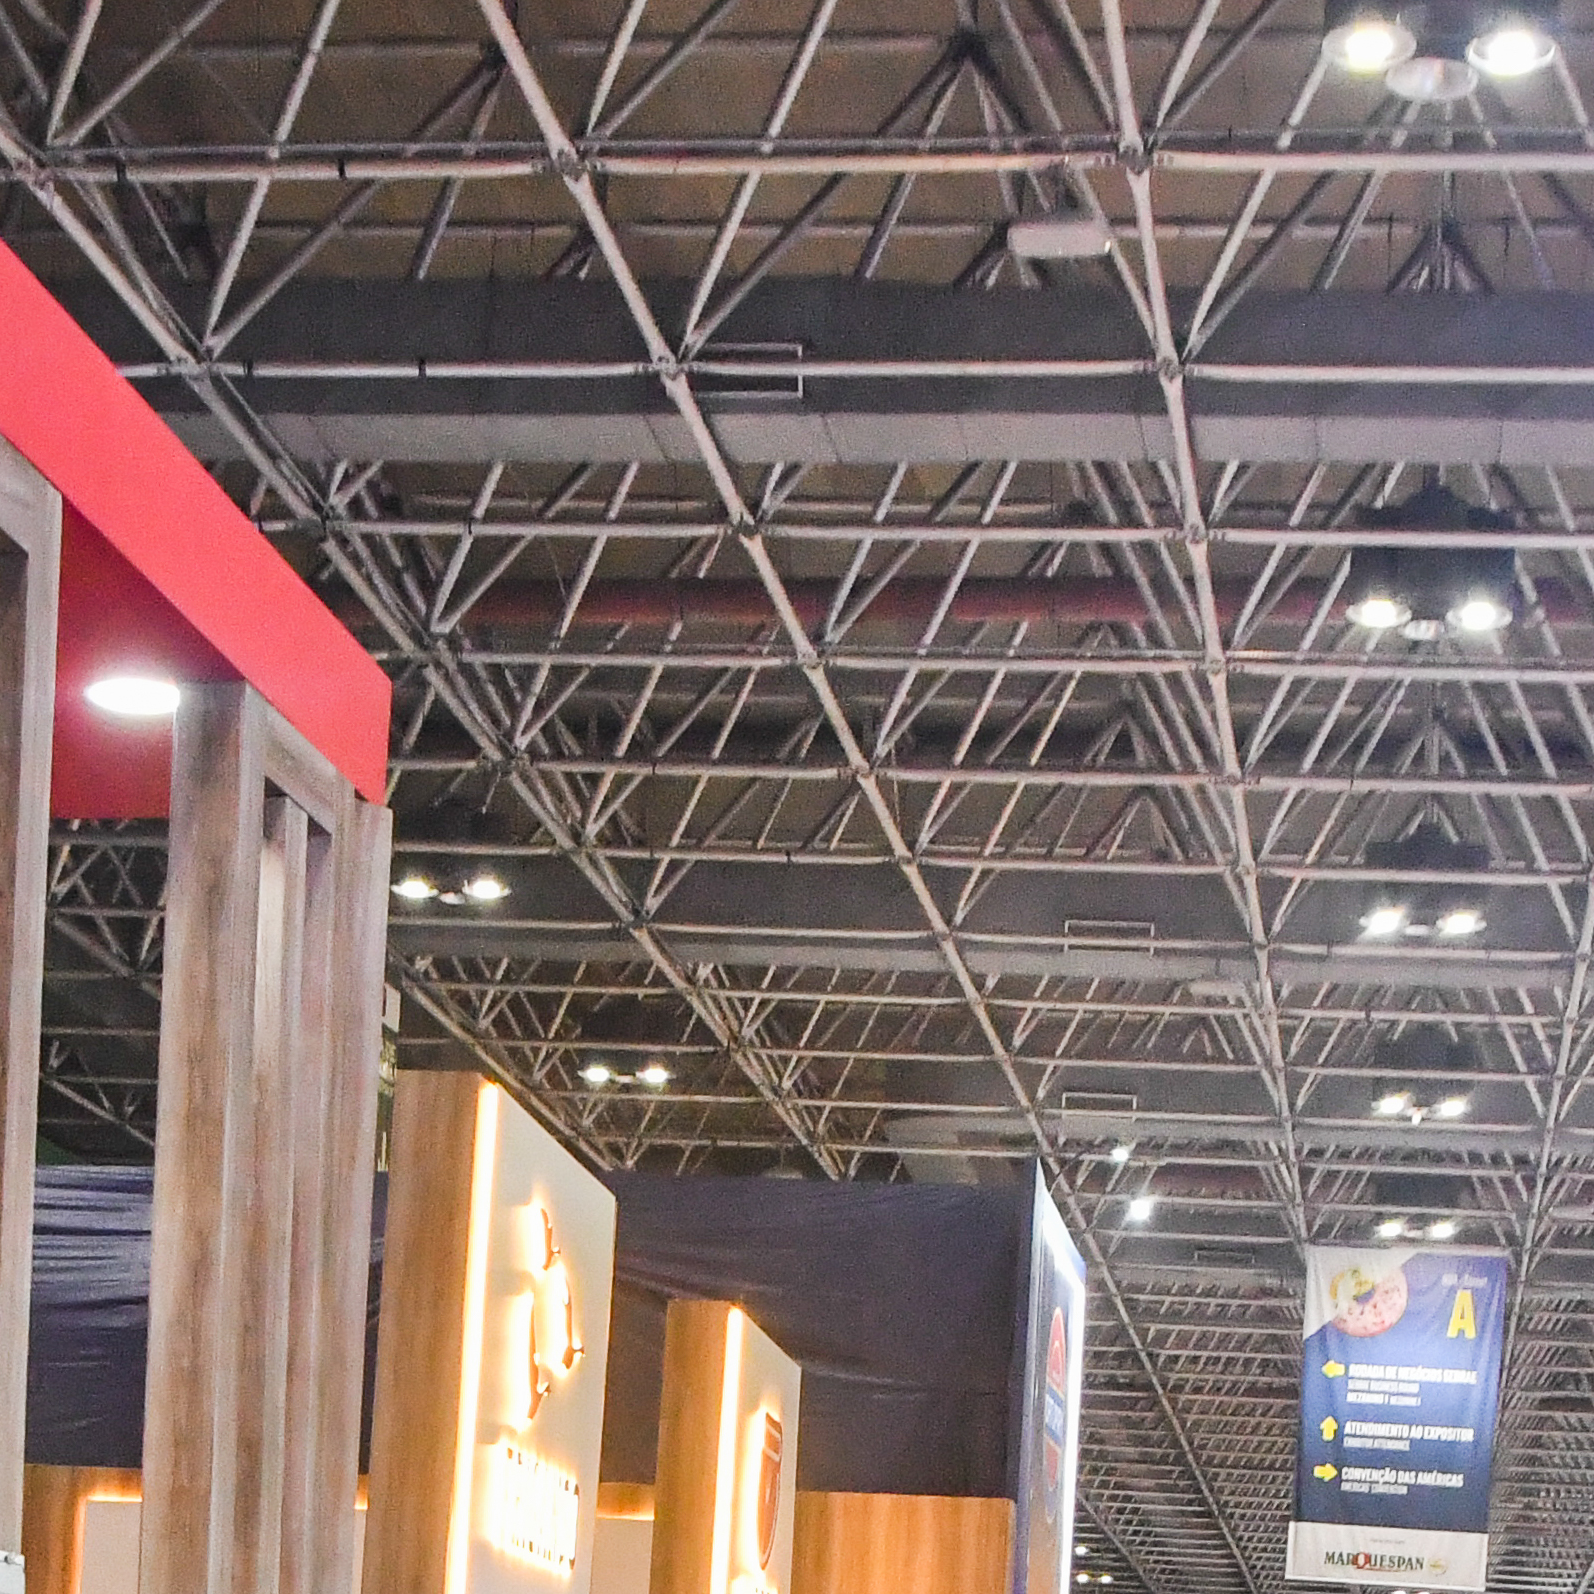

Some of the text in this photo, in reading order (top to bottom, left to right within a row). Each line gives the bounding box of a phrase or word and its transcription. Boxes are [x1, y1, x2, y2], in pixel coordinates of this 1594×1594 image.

[1447, 1288, 1477, 1340] A
[1344, 1421, 1475, 1442] ATENDIMENTO AO EXPOSITOR
[1341, 1466, 1397, 1484] CONVENÇÃO
[1397, 1470, 1416, 1484] DAS
[1416, 1470, 1464, 1488] AMÉRICAS
